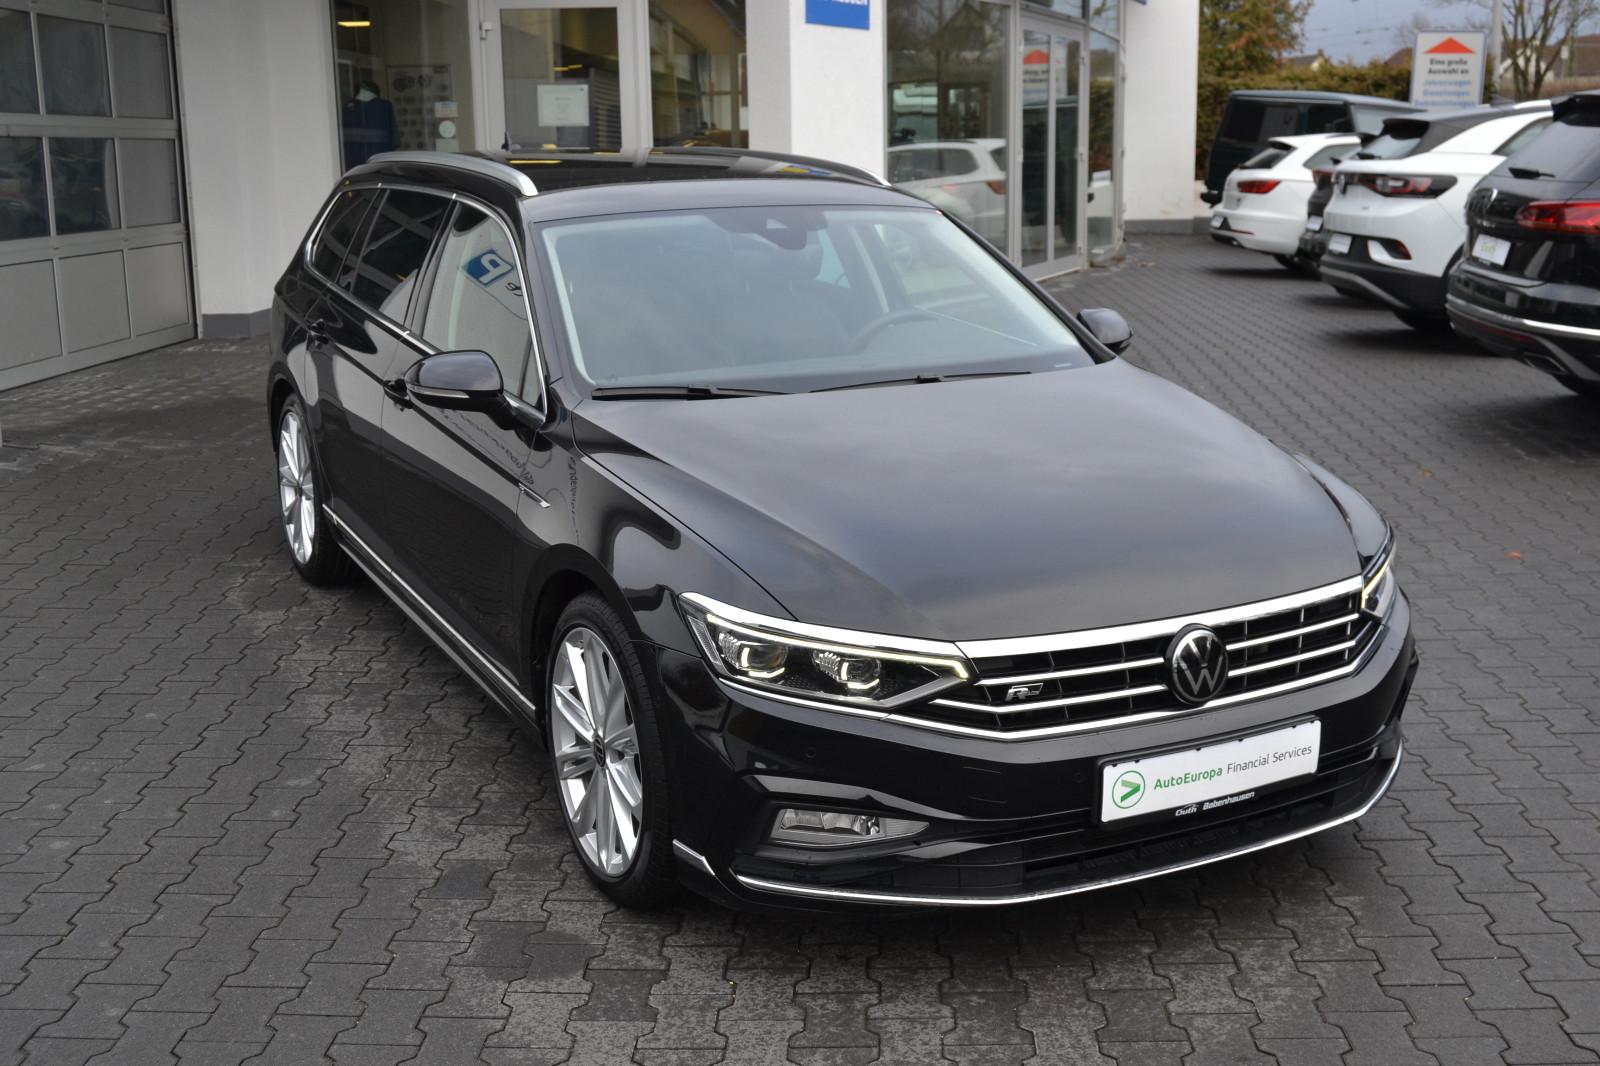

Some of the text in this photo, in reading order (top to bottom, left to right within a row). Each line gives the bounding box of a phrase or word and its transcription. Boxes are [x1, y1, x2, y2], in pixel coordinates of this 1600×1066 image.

[1427, 67, 1459, 75] Auswahl
[1154, 745, 1312, 790] AutoEuropa Financial Services
[1203, 791, 1255, 810] Babenhausen
